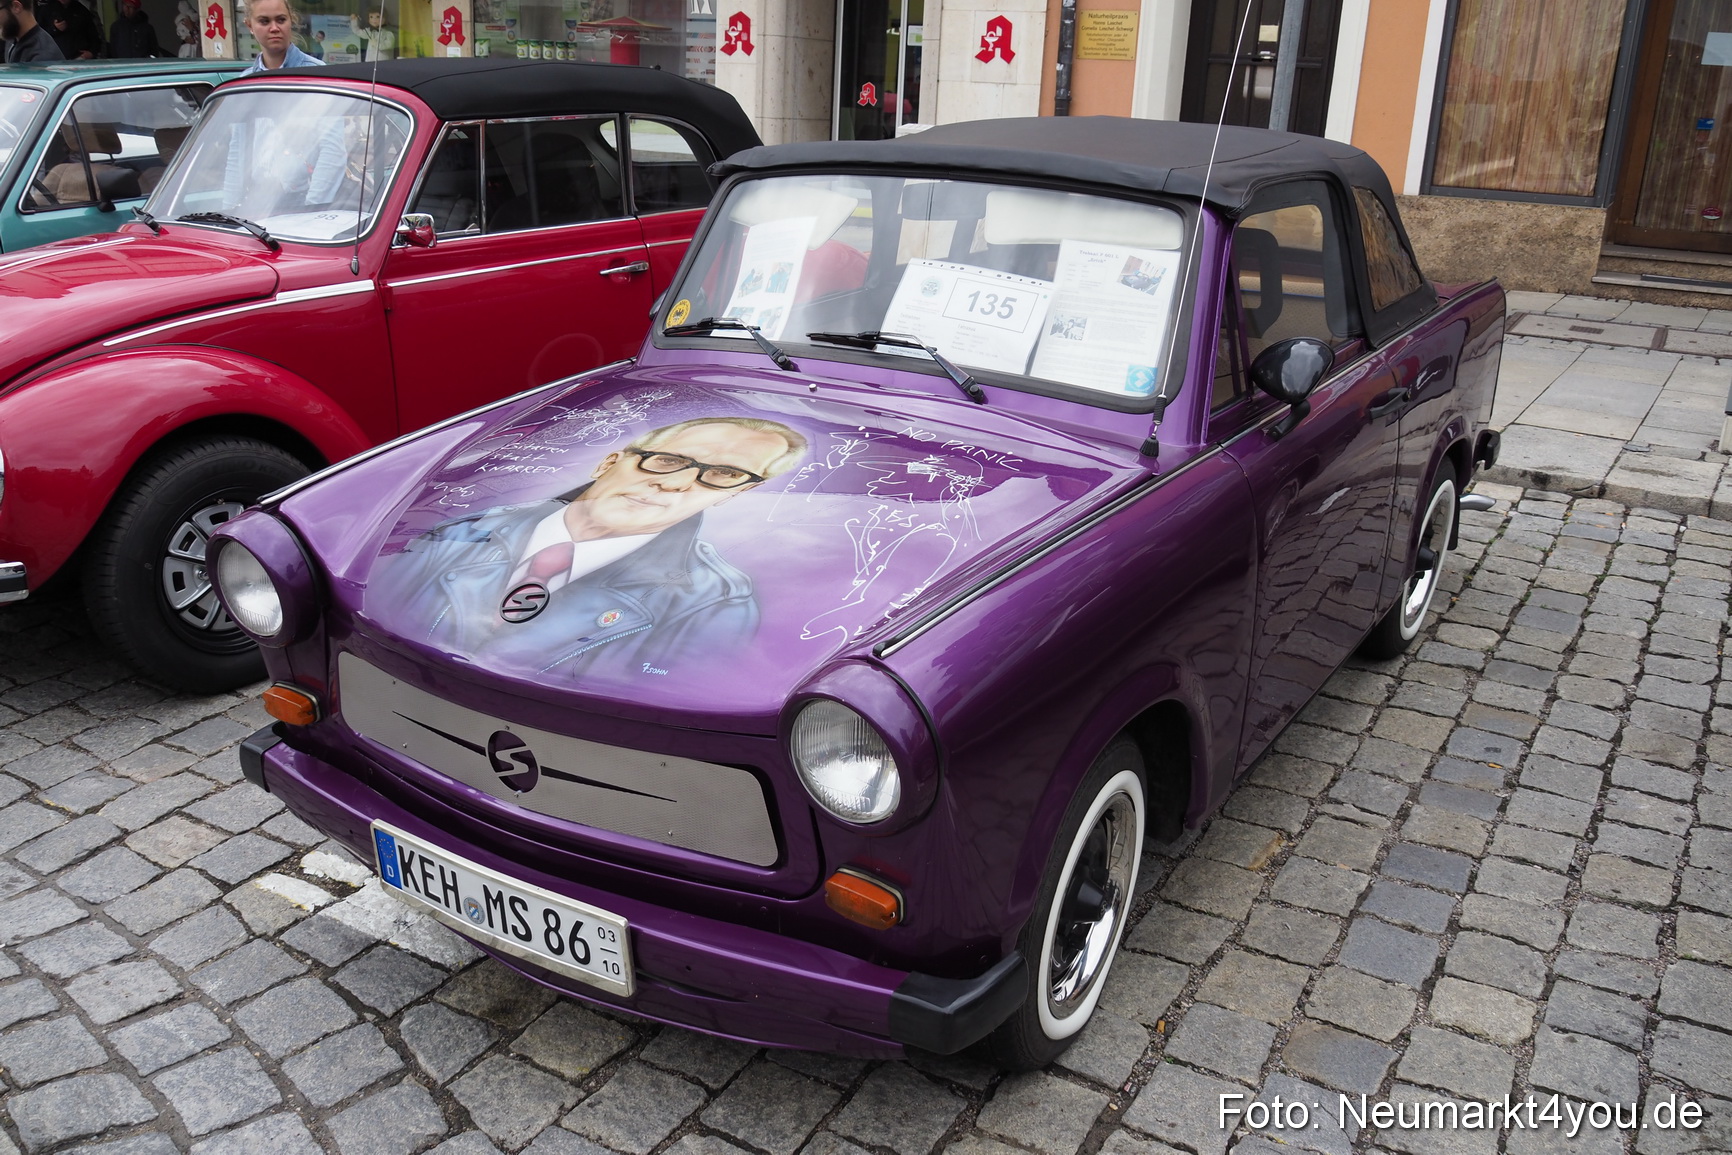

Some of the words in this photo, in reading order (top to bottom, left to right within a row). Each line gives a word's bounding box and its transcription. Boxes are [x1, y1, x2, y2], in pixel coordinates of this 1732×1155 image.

[967, 290, 1018, 320] 135
[897, 426, 937, 442] NO
[474, 462, 564, 474] KNARREN
[386, 864, 395, 879] D
[397, 844, 462, 915] KEH
[482, 884, 533, 943] MS
[543, 908, 592, 966] 86
[597, 926, 617, 943] 03
[602, 959, 621, 976] 10
